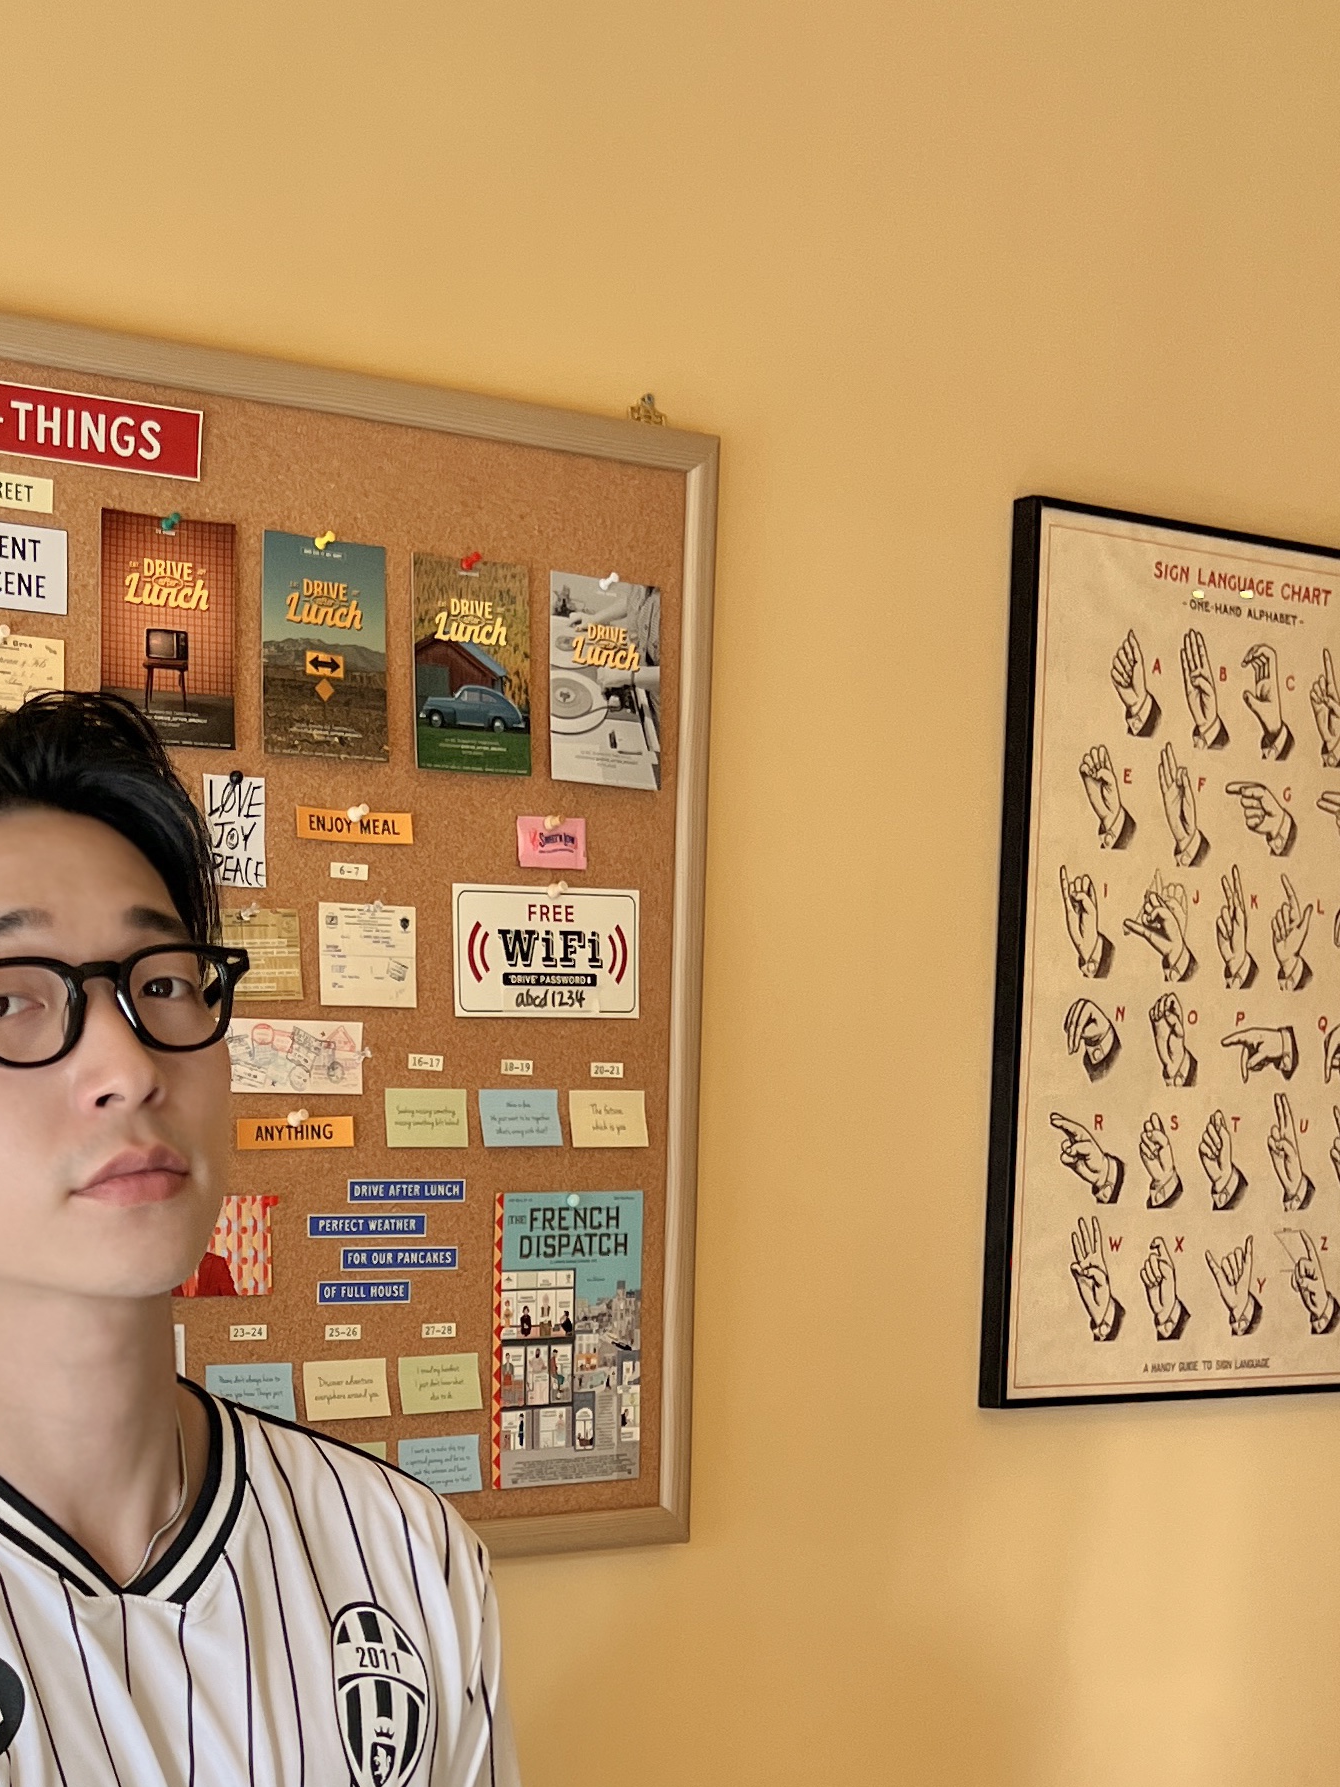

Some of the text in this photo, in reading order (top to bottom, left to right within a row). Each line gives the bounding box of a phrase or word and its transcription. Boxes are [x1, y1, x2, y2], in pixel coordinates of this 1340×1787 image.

[144, 557, 193, 581] DRIVE
[124, 572, 209, 611] Lunch
[303, 578, 348, 601] DRIVE
[1154, 561, 1332, 607] SIGN LANGUAGE CHART
[285, 592, 363, 631] Lunch
[450, 598, 493, 619] DRIVE
[1247, 609, 1297, 626] ALPHABET
[434, 611, 508, 647] Lunch
[587, 623, 628, 643] DRIVE
[571, 636, 641, 672] Lunch
[1152, 658, 1295, 691] A B C
[1123, 768, 1292, 802] E F G
[309, 814, 400, 836] ENJOY MEAL
[212, 821, 256, 851] JOY
[212, 853, 265, 887] PEACE
[339, 865, 360, 876] 6-7
[1103, 883, 1324, 915] I J K L
[528, 904, 575, 923] FREE
[497, 928, 603, 969] WiFi
[1115, 1006, 1328, 1034] N O P Q
[412, 1056, 441, 1069] 16-17
[503, 1061, 531, 1073] 18-19
[593, 1065, 621, 1076] 20-21
[255, 1124, 334, 1142] ANYTHING
[1094, 1114, 1308, 1133] R S T U
[354, 1184, 460, 1198] DRIVE AFTER LUNCH
[318, 1218, 416, 1232] PERFECT WEATHER
[508, 1205, 620, 1232] THE FRENCH
[519, 1233, 628, 1259] DISPATCH
[1109, 1236, 1328, 1252] W X Z
[347, 1251, 452, 1265] FOR OUR PANCAKES
[323, 1285, 405, 1298] OF FULL HOUSE
[1256, 1277, 1267, 1294] Y
[233, 1327, 263, 1338] 23-24
[328, 1327, 358, 1338] 25-26
[425, 1325, 453, 1336] 27-28
[355, 1647, 400, 1675] 2011
